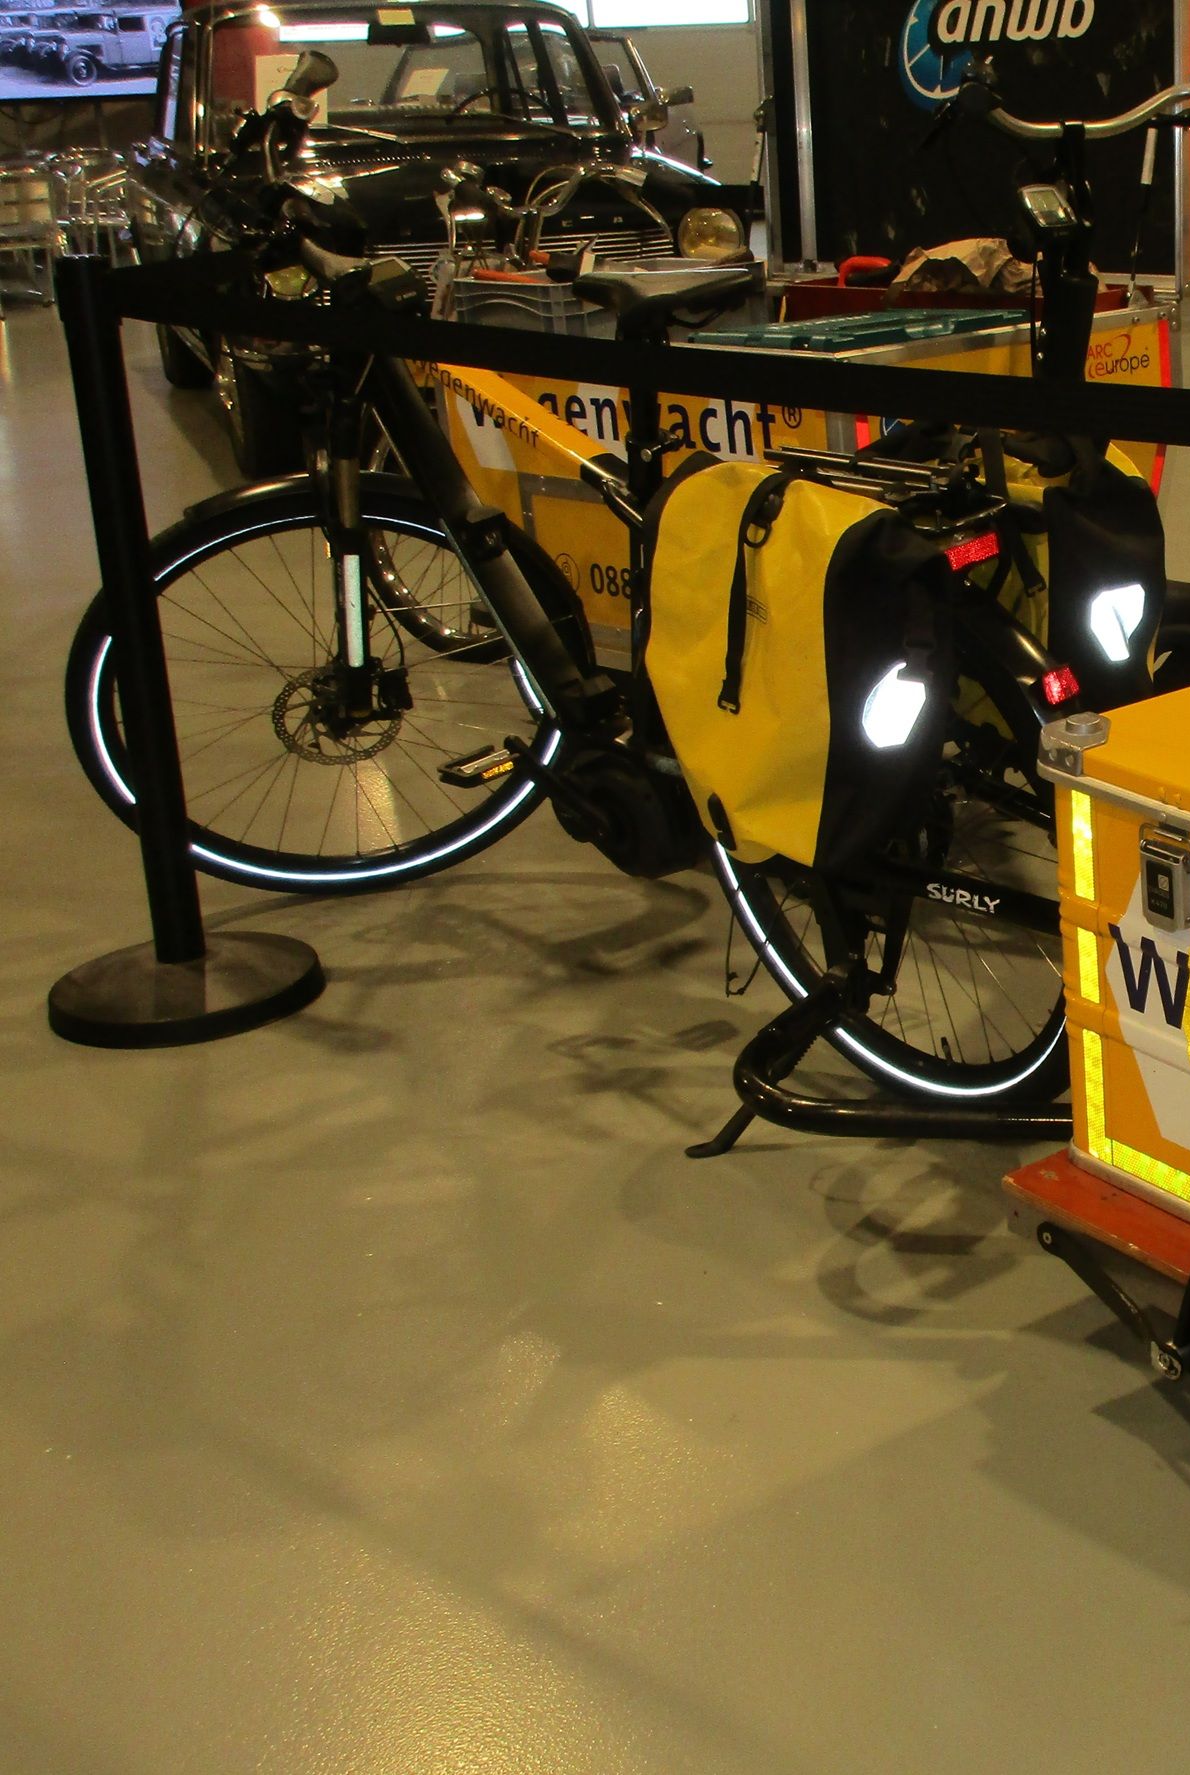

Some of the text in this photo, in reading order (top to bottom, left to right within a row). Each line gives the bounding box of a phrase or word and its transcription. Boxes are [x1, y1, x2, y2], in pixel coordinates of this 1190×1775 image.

[937, 0, 1096, 43] anwb
[1087, 342, 1113, 360] ARC
[1095, 354, 1150, 376] europe
[926, 883, 1001, 914] SURLY
